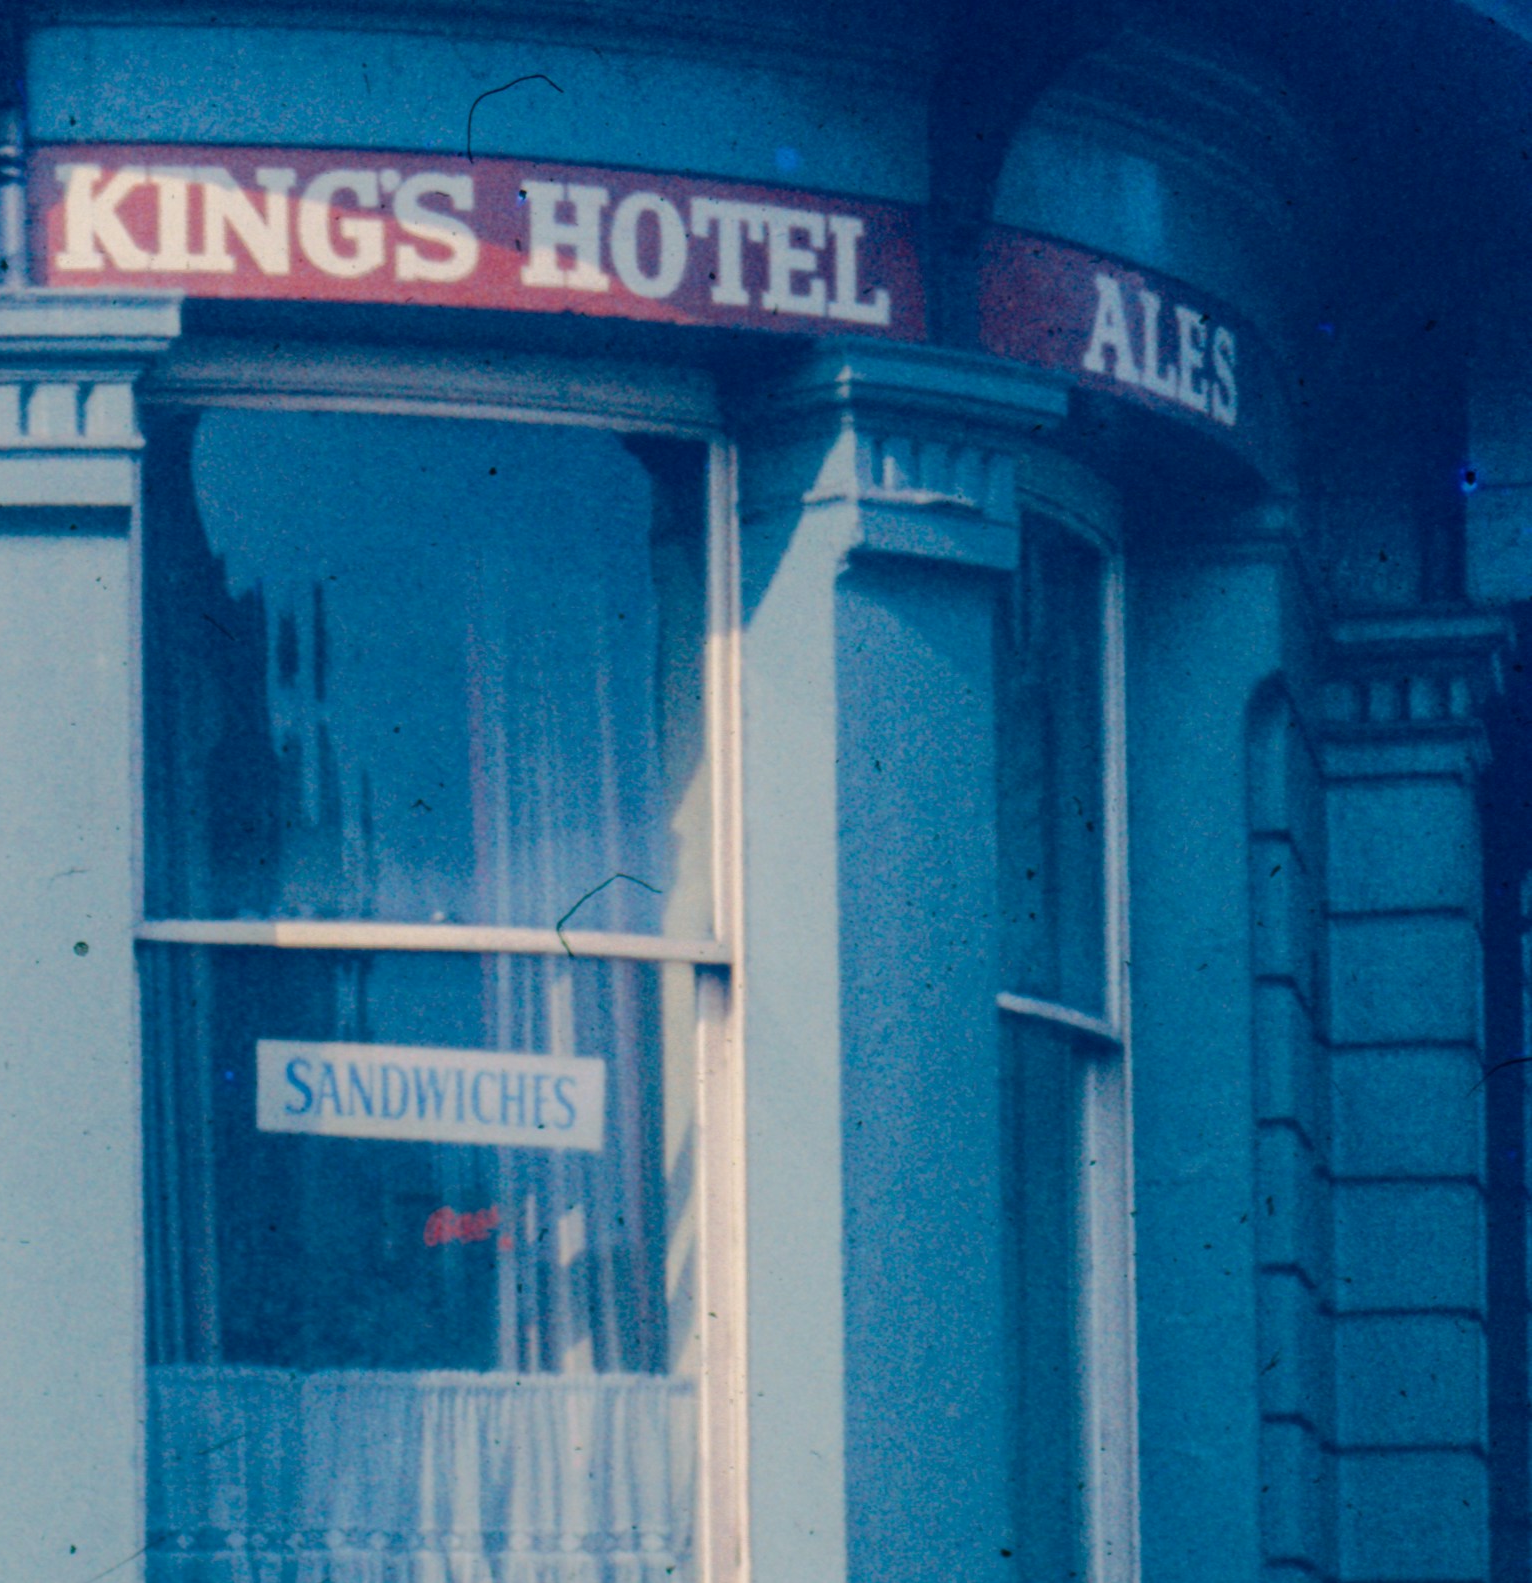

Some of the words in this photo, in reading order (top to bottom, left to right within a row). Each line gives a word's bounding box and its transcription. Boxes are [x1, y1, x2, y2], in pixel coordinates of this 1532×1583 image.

[55, 163, 480, 282] KING'S
[521, 179, 892, 326] HOTEL
[1082, 272, 1238, 427] ALES
[284, 1056, 578, 1131] SANDWICHES
